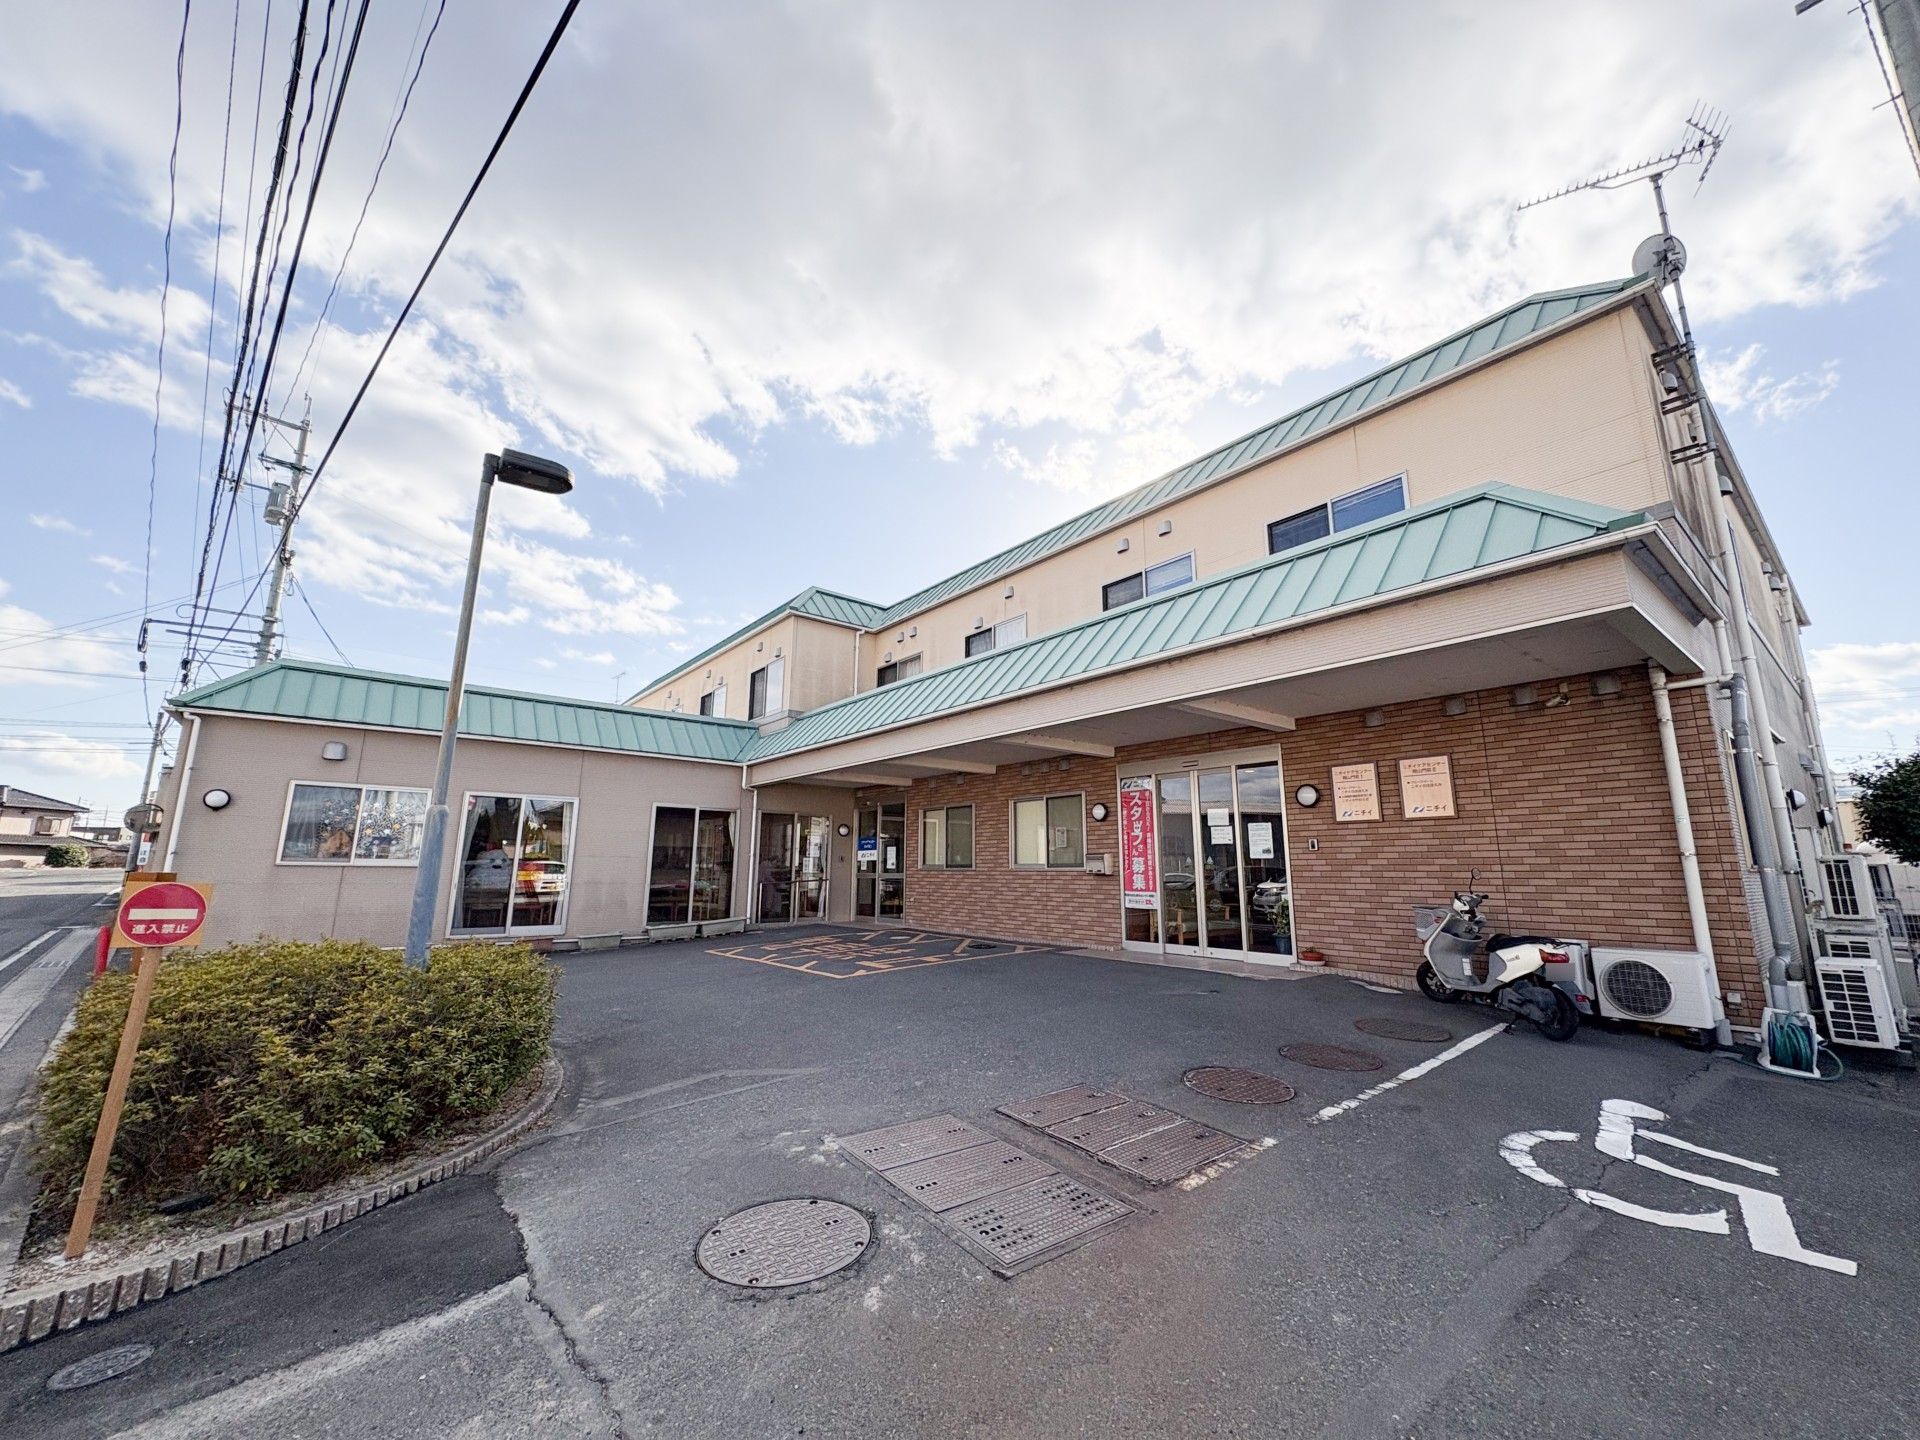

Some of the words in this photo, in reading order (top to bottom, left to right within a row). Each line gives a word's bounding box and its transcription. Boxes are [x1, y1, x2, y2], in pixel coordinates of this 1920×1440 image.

[1426, 804, 1447, 812] ニチイ
[1129, 791, 1146, 891] スタッフさん募集
[131, 923, 189, 935] 進入禁止
